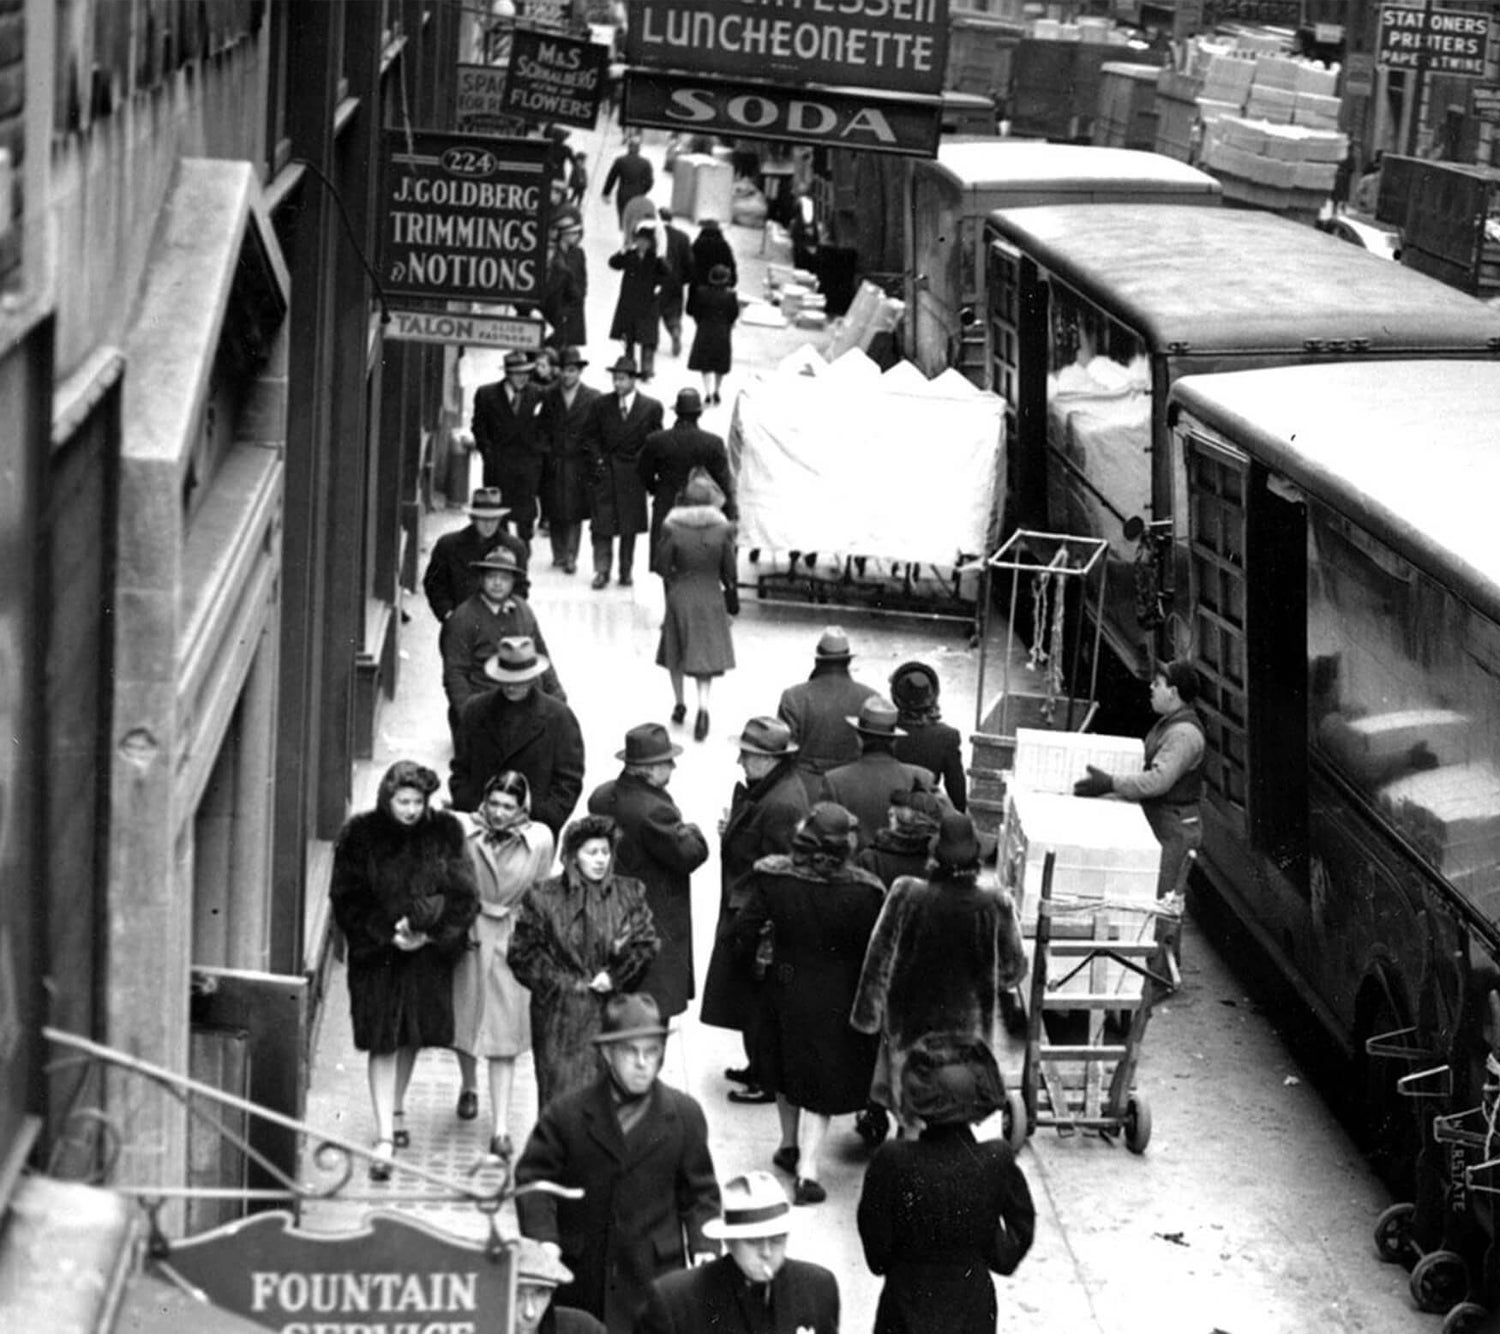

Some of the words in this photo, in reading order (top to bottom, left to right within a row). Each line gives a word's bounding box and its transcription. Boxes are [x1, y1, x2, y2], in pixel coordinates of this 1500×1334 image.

[643, 7, 934, 72] LUNCHEONETTE
[1383, 9, 1487, 35] STATONERS
[1381, 49, 1419, 66] PAPE
[510, 88, 593, 119] FLOWERS
[664, 88, 897, 143] SODA
[449, 152, 491, 173] 224
[390, 211, 538, 252] TRIMMINGS
[408, 251, 536, 292] NOTIONS
[395, 314, 474, 339] TALON
[252, 1271, 478, 1312] FOUNTAIN
